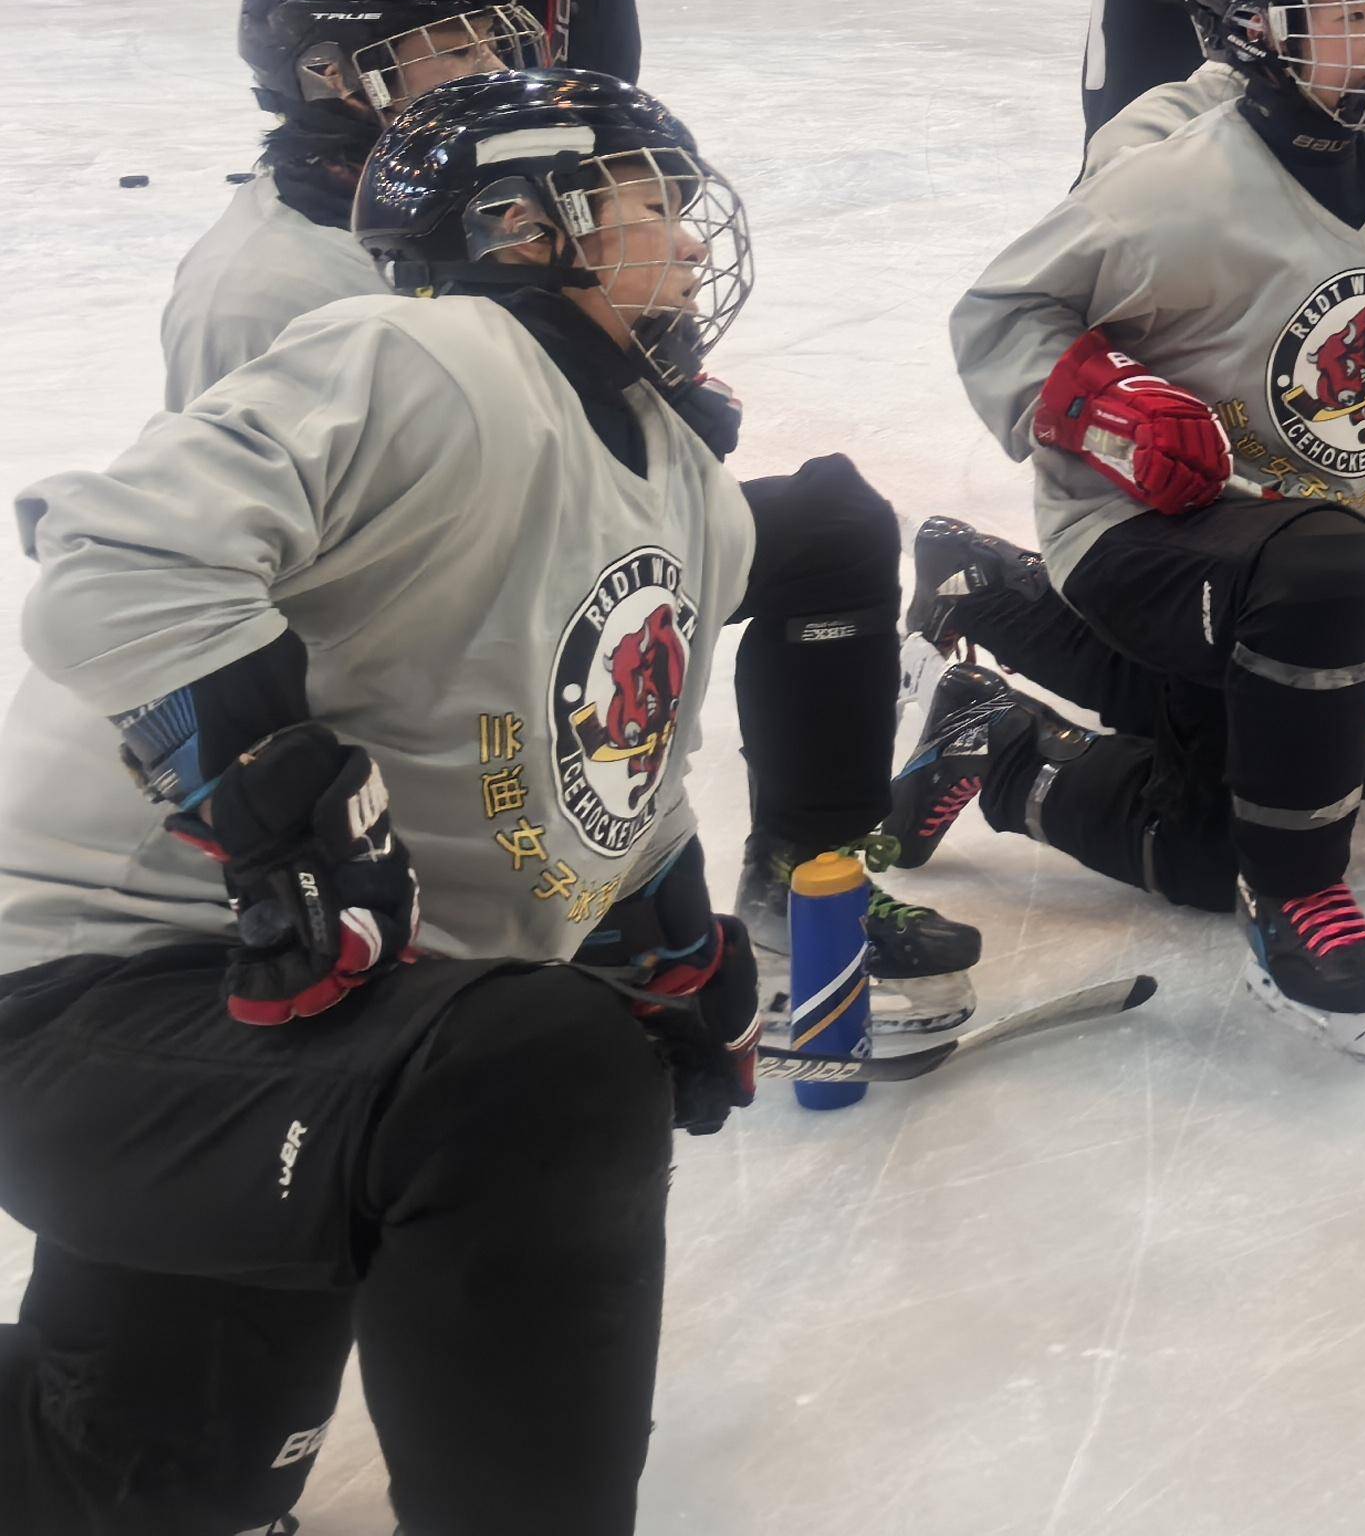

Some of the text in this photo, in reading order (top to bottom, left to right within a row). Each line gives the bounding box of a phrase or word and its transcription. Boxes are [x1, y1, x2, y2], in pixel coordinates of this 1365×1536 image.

[311, 13, 383, 21] TRUE
[1290, 283, 1343, 340] R&DT
[585, 559, 642, 632] R&DT
